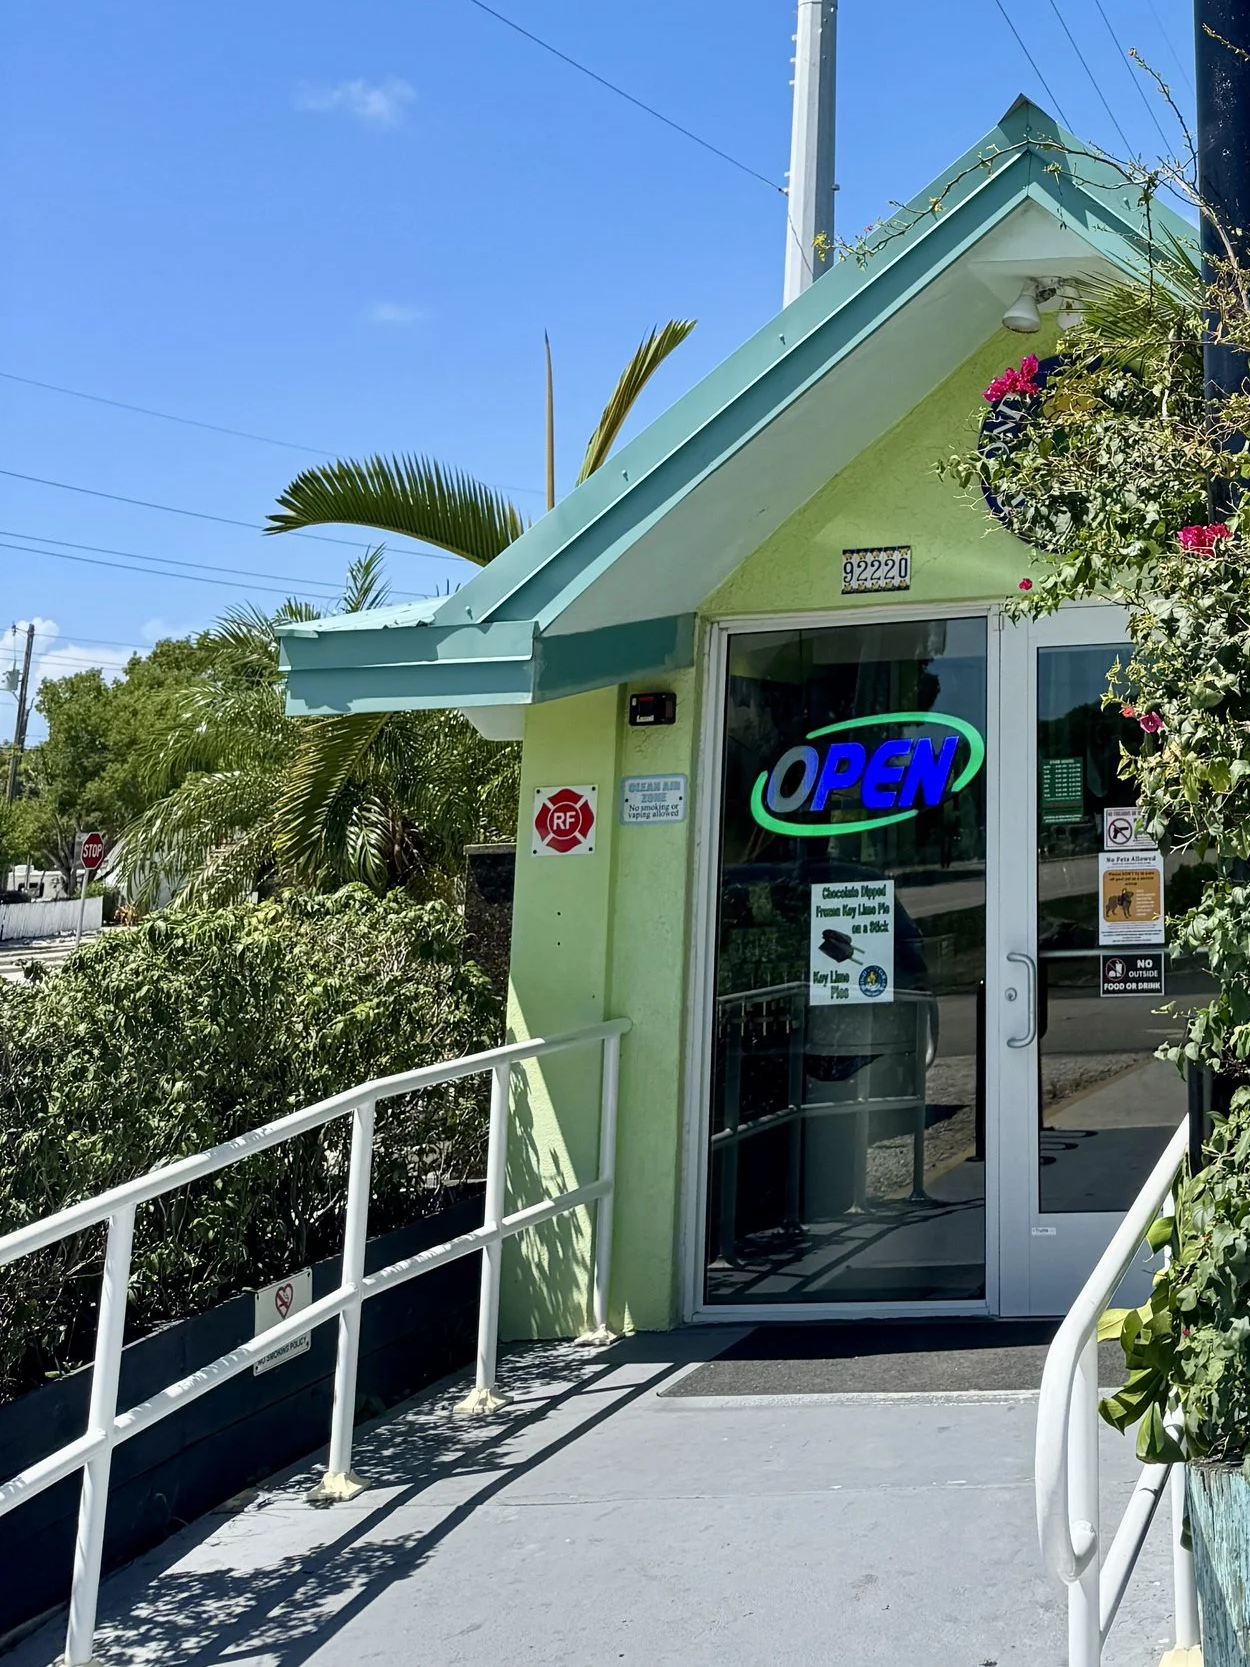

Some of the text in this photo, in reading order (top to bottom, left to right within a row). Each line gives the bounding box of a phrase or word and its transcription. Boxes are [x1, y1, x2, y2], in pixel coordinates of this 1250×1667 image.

[843, 557, 908, 583] 92220
[766, 735, 960, 814] OPEN
[628, 809, 679, 820] vaping allowed
[629, 804, 640, 812] No
[641, 803, 669, 812] smoking
[553, 810, 576, 831] RF
[83, 844, 103, 858] STOP
[822, 884, 887, 900] Chocolate Dipped
[842, 904, 857, 919] Key
[858, 903, 876, 916] Lime
[877, 902, 890, 915] Pie
[852, 920, 889, 934] on a Stick
[1136, 959, 1153, 969] NO
[813, 970, 829, 987] Key
[830, 970, 850, 984] Lime
[1104, 982, 1125, 990] FOOD
[830, 985, 849, 1000] Pies
[290, 1335, 307, 1350] POLICY
